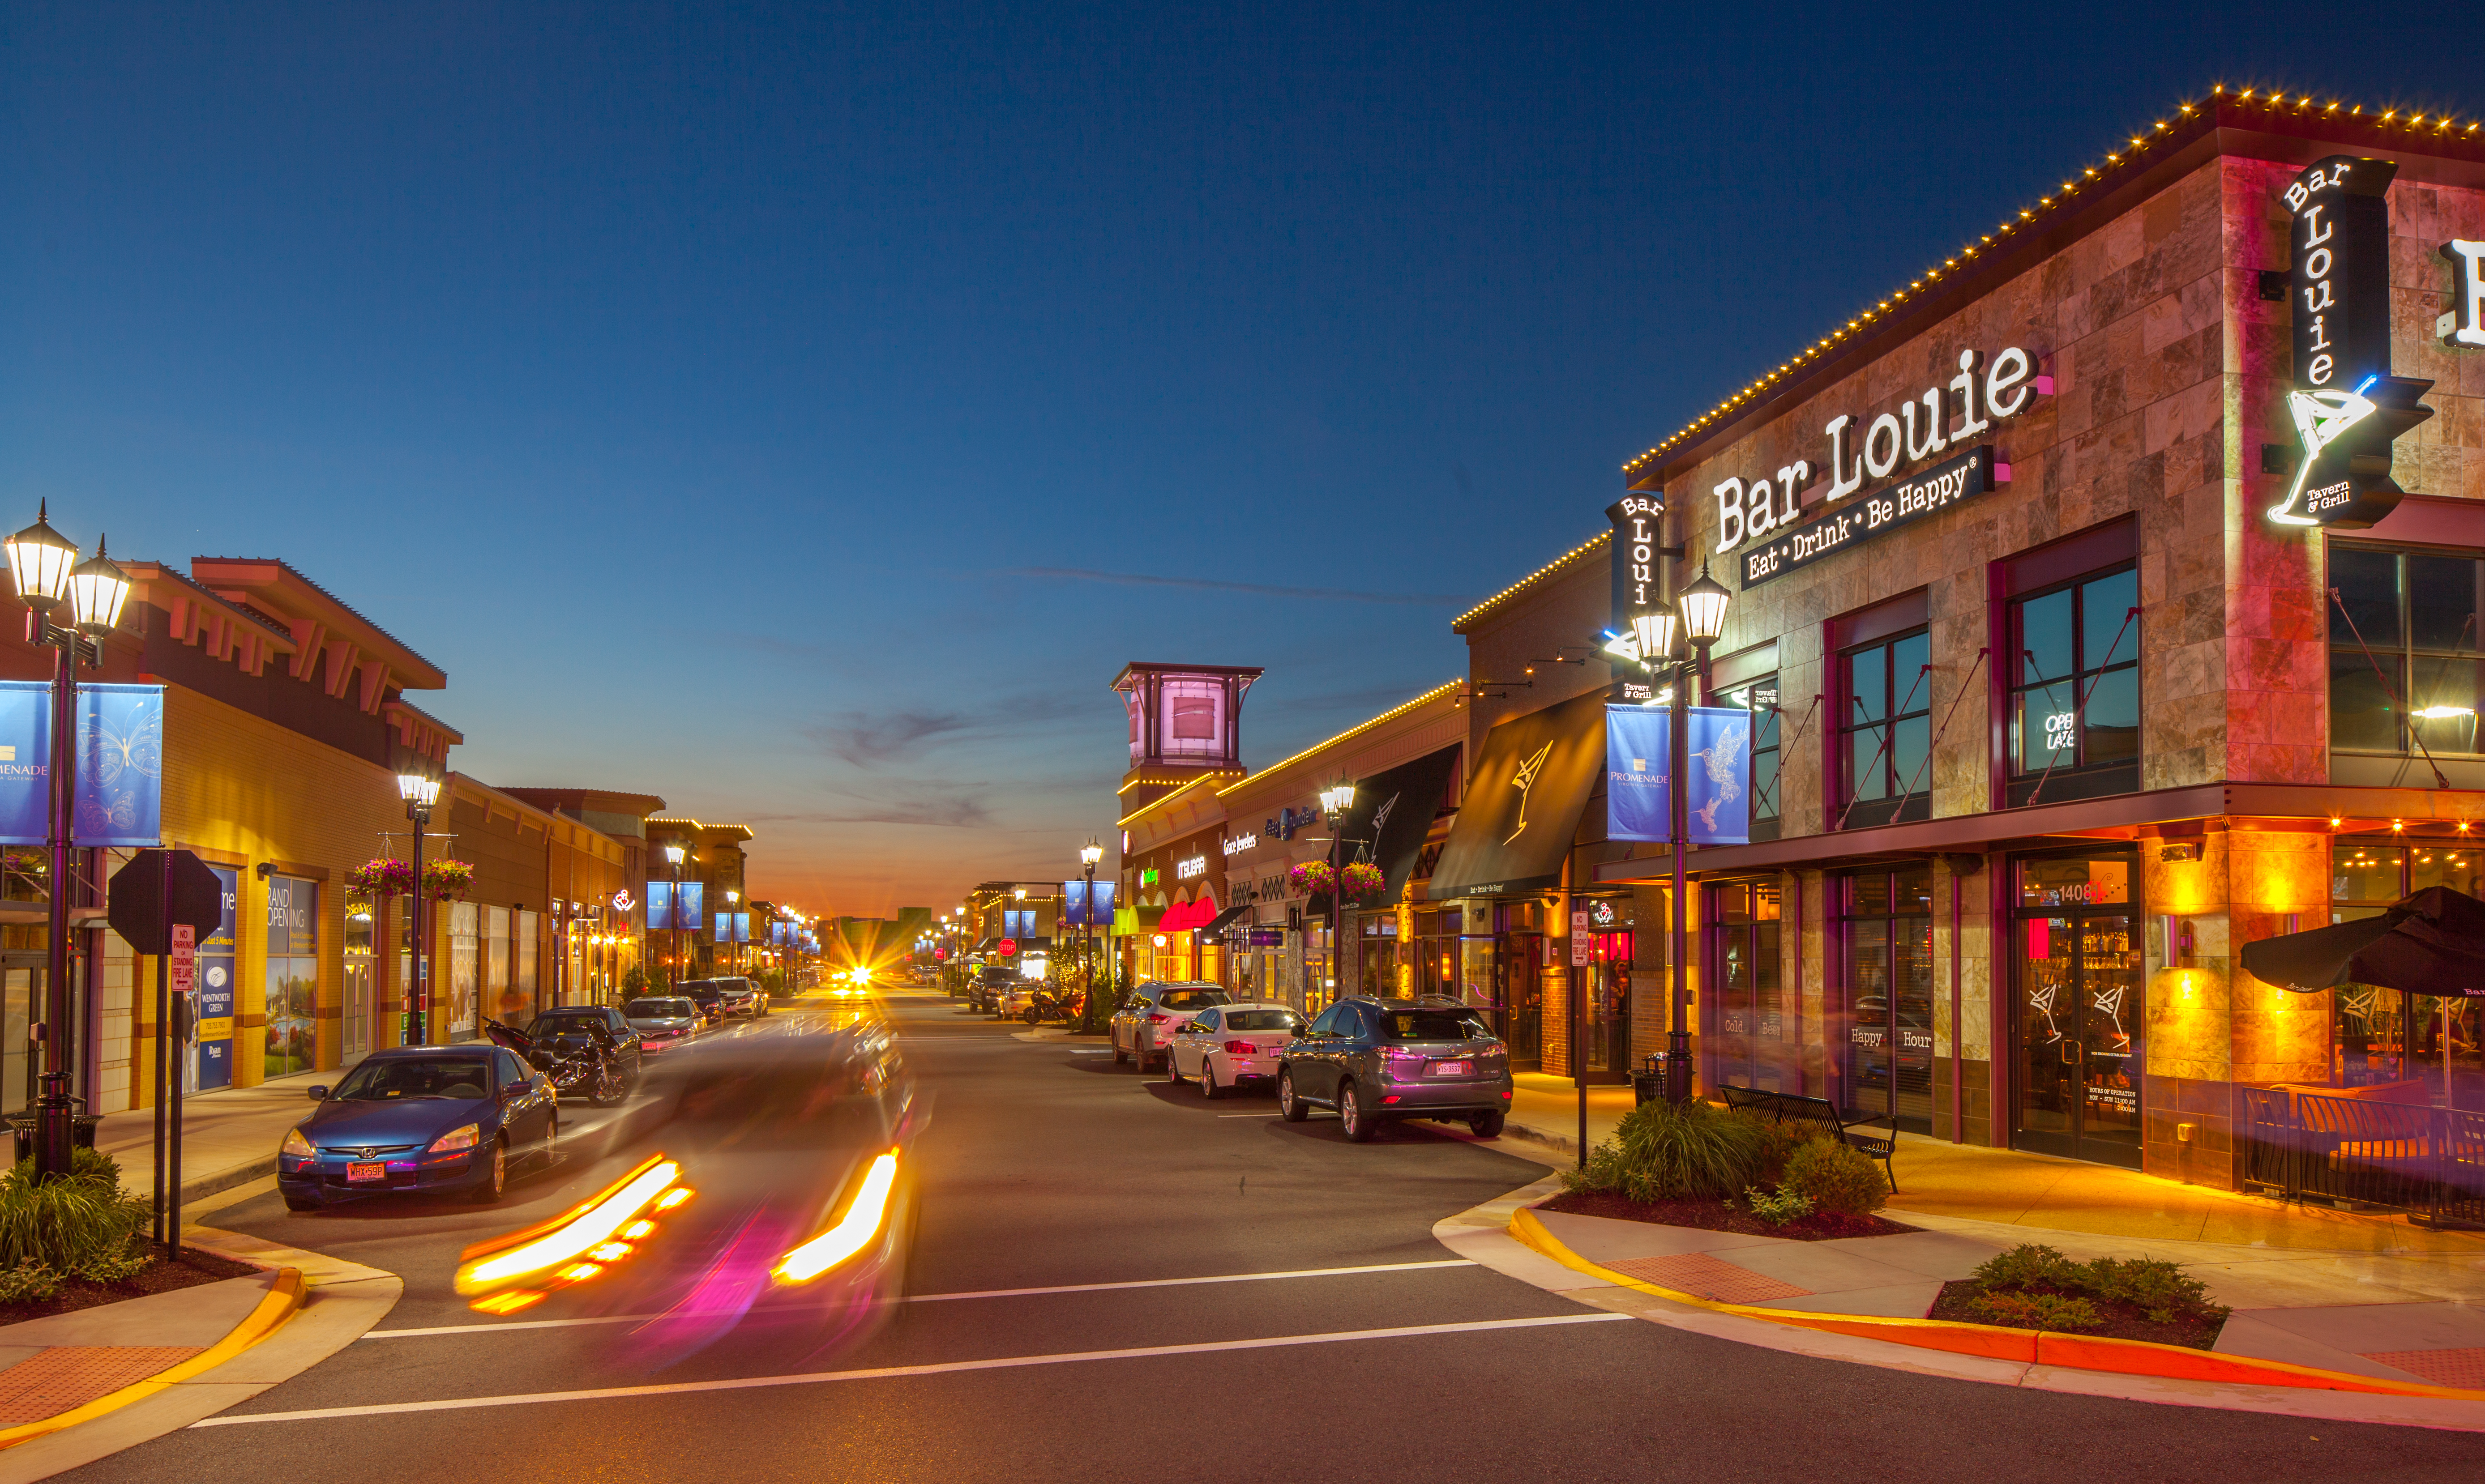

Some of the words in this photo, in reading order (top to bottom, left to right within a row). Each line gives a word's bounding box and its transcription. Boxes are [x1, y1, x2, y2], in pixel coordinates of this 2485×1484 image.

[2284, 163, 2351, 212] Bar
[2304, 205, 2334, 385] Louie
[1713, 460, 1808, 554] Bar
[1825, 347, 2028, 502] Louie
[2307, 481, 2350, 501] Tavern
[1621, 498, 1664, 516] Bar
[2308, 500, 2318, 513] &
[2321, 491, 2350, 509] Grill
[1749, 546, 1778, 580] Eat
[1792, 516, 1851, 561] Drink
[1867, 499, 1893, 529] Be
[1633, 519, 1652, 605] Loui
[2047, 730, 2074, 750] LATE
[1611, 772, 1668, 784] PROMENADE
[1289, 806, 1312, 828] number
[1224, 839, 1236, 855] Grace
[1236, 832, 1256, 855] Jewelers
[267, 887, 289, 908] RAND
[2059, 884, 2098, 901] 14081
[267, 907, 304, 928] OPENING
[180, 930, 188, 938] NO
[207, 936, 215, 944] Just
[216, 936, 219, 944] 5
[219, 936, 234, 945] Minutes
[174, 941, 193, 949] PARKING
[174, 958, 192, 966] STANDING
[173, 968, 181, 977] FIRE
[183, 968, 192, 977] LANE
[202, 993, 230, 1002] WENTWORTH
[209, 1003, 223, 1012] GREEN
[1725, 1019, 1743, 1032] Cold
[1852, 1028, 1882, 1047] Happy
[1903, 1032, 1932, 1048] Hour
[209, 1045, 221, 1058] Ryan
